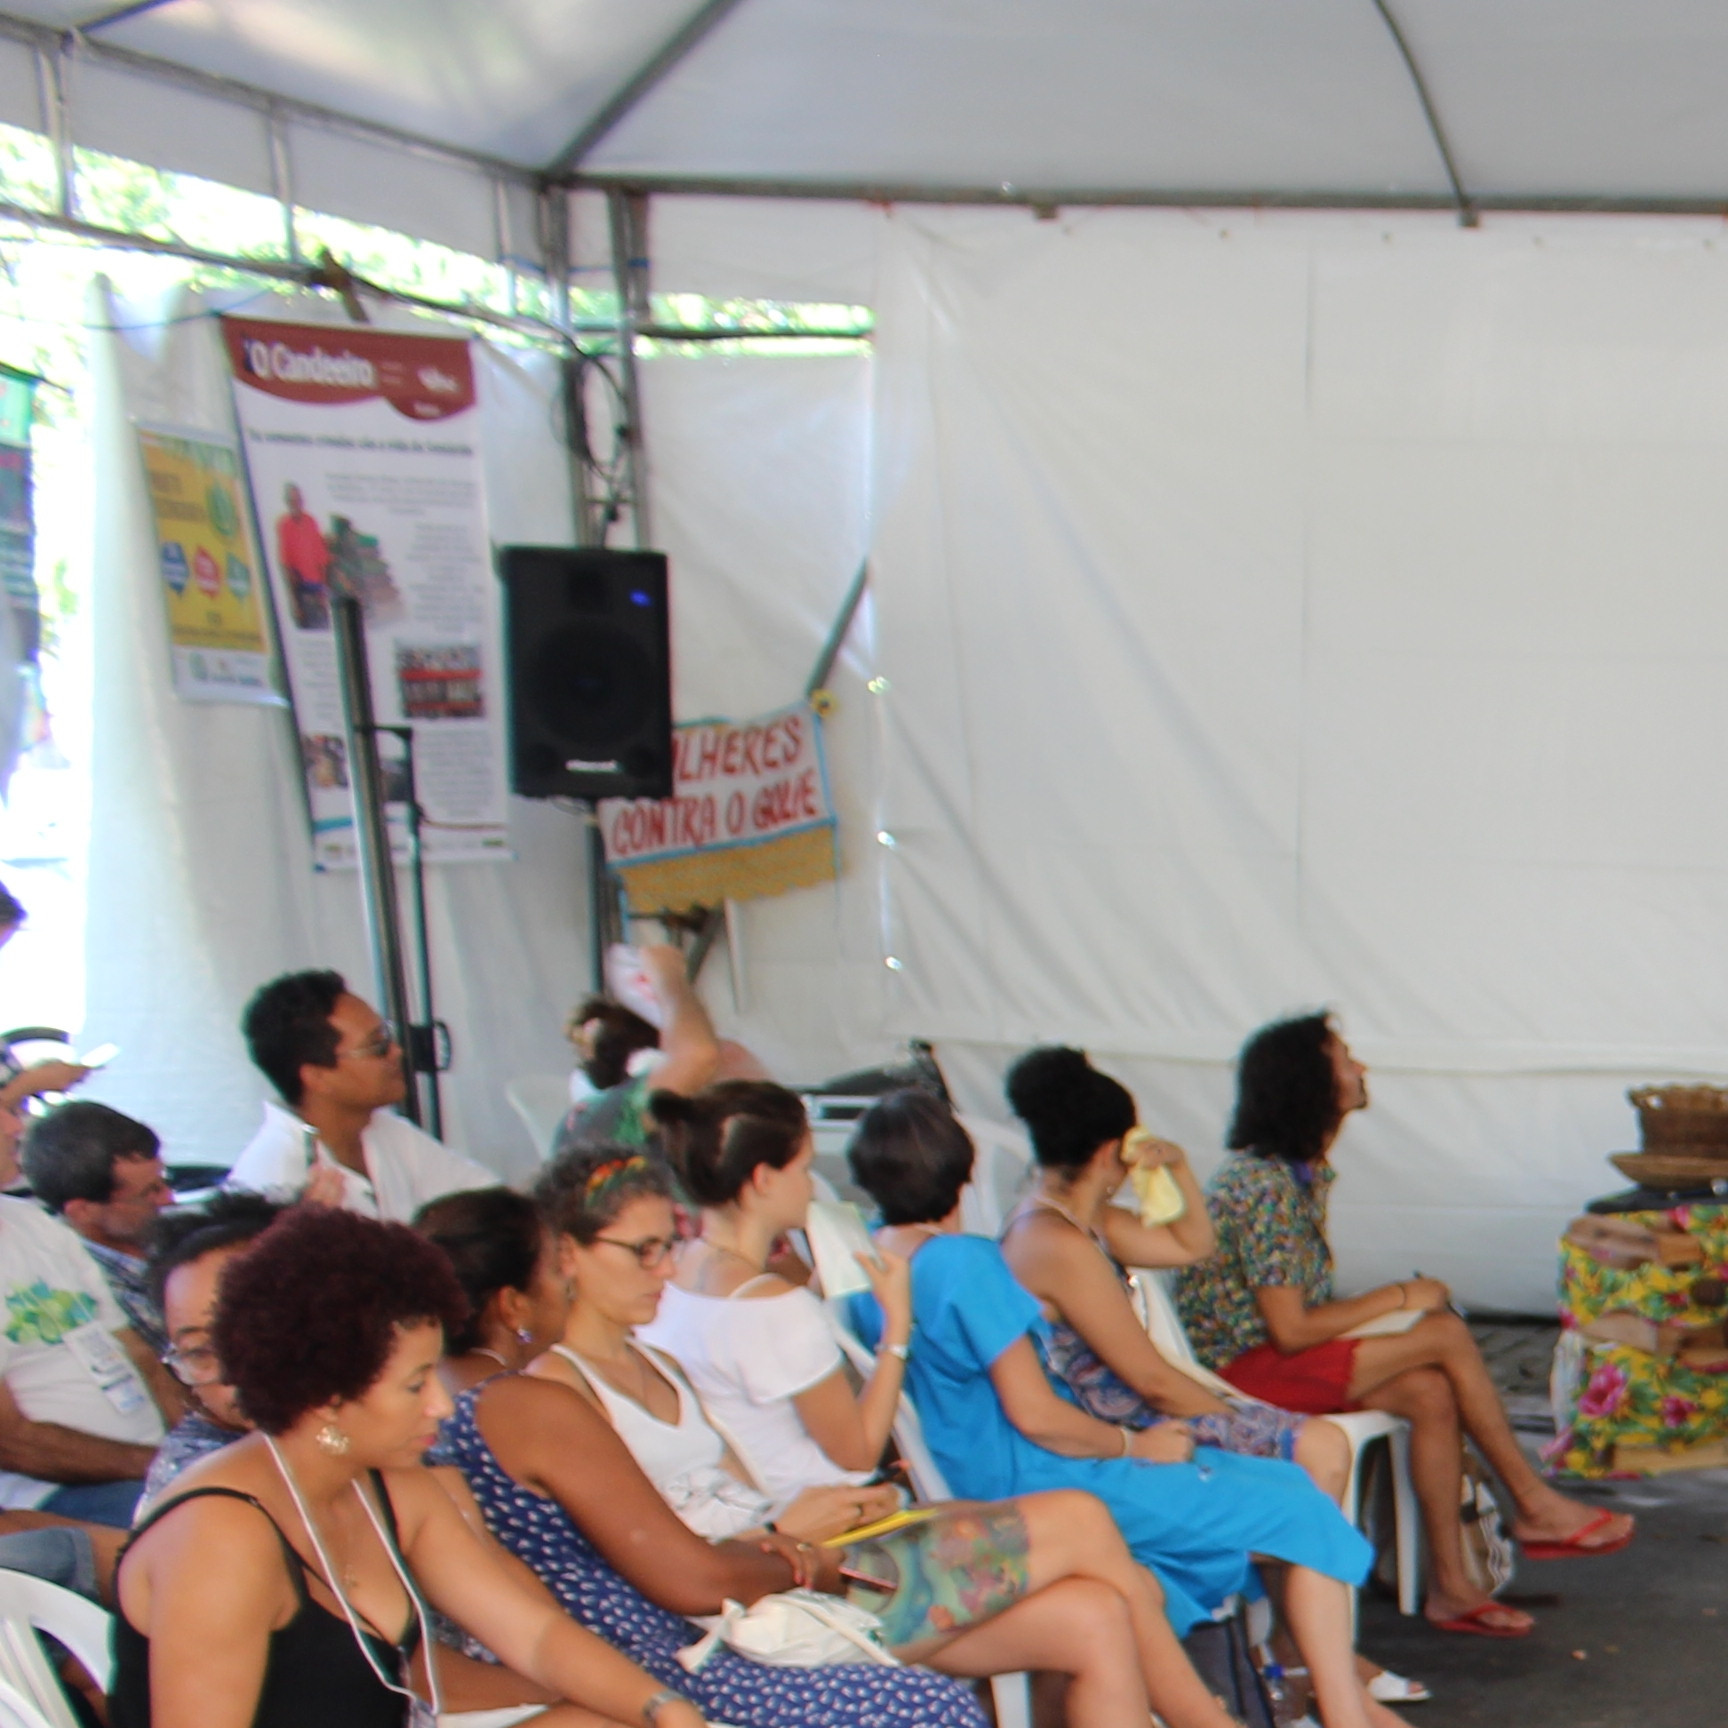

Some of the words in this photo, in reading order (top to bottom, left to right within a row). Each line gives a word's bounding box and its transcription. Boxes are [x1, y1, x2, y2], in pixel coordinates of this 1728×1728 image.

[271, 341, 378, 389] Candeeiro
[672, 714, 802, 782] LHERES
[613, 794, 716, 855] CONTRA
[726, 790, 745, 835] O
